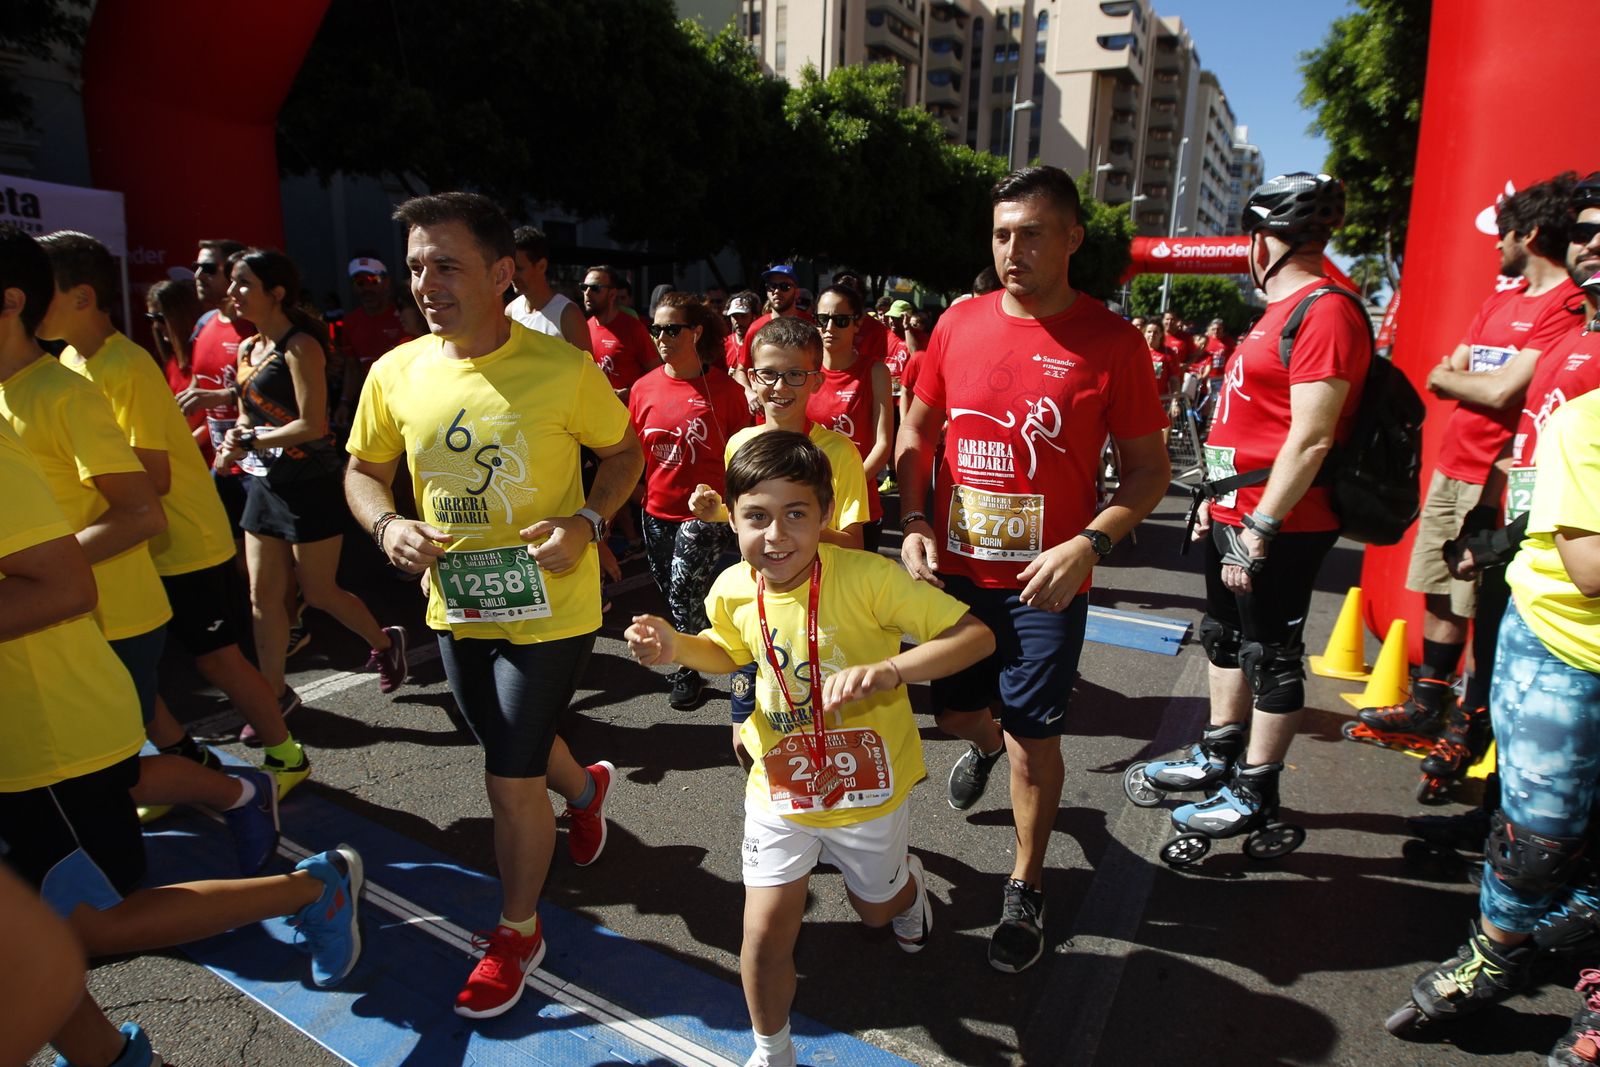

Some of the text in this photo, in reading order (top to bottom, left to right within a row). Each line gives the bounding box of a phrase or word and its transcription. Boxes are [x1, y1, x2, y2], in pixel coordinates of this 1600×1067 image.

[1172, 243, 1249, 258] Santander
[1042, 355, 1076, 368] Santander
[958, 438, 1014, 459] CARRERA
[958, 454, 1015, 472] SOLIDARIA
[432, 497, 488, 511] CARRERA
[435, 510, 490, 524] SOLIDARIA
[957, 508, 1025, 538] 3270
[980, 536, 1002, 548] DORIN
[452, 553, 461, 569] 6
[463, 552, 502, 562] CARRERA
[449, 570, 525, 597] 1258
[480, 596, 507, 608] EMILIO
[786, 737, 797, 752] 6
[772, 792, 790, 801] niños
